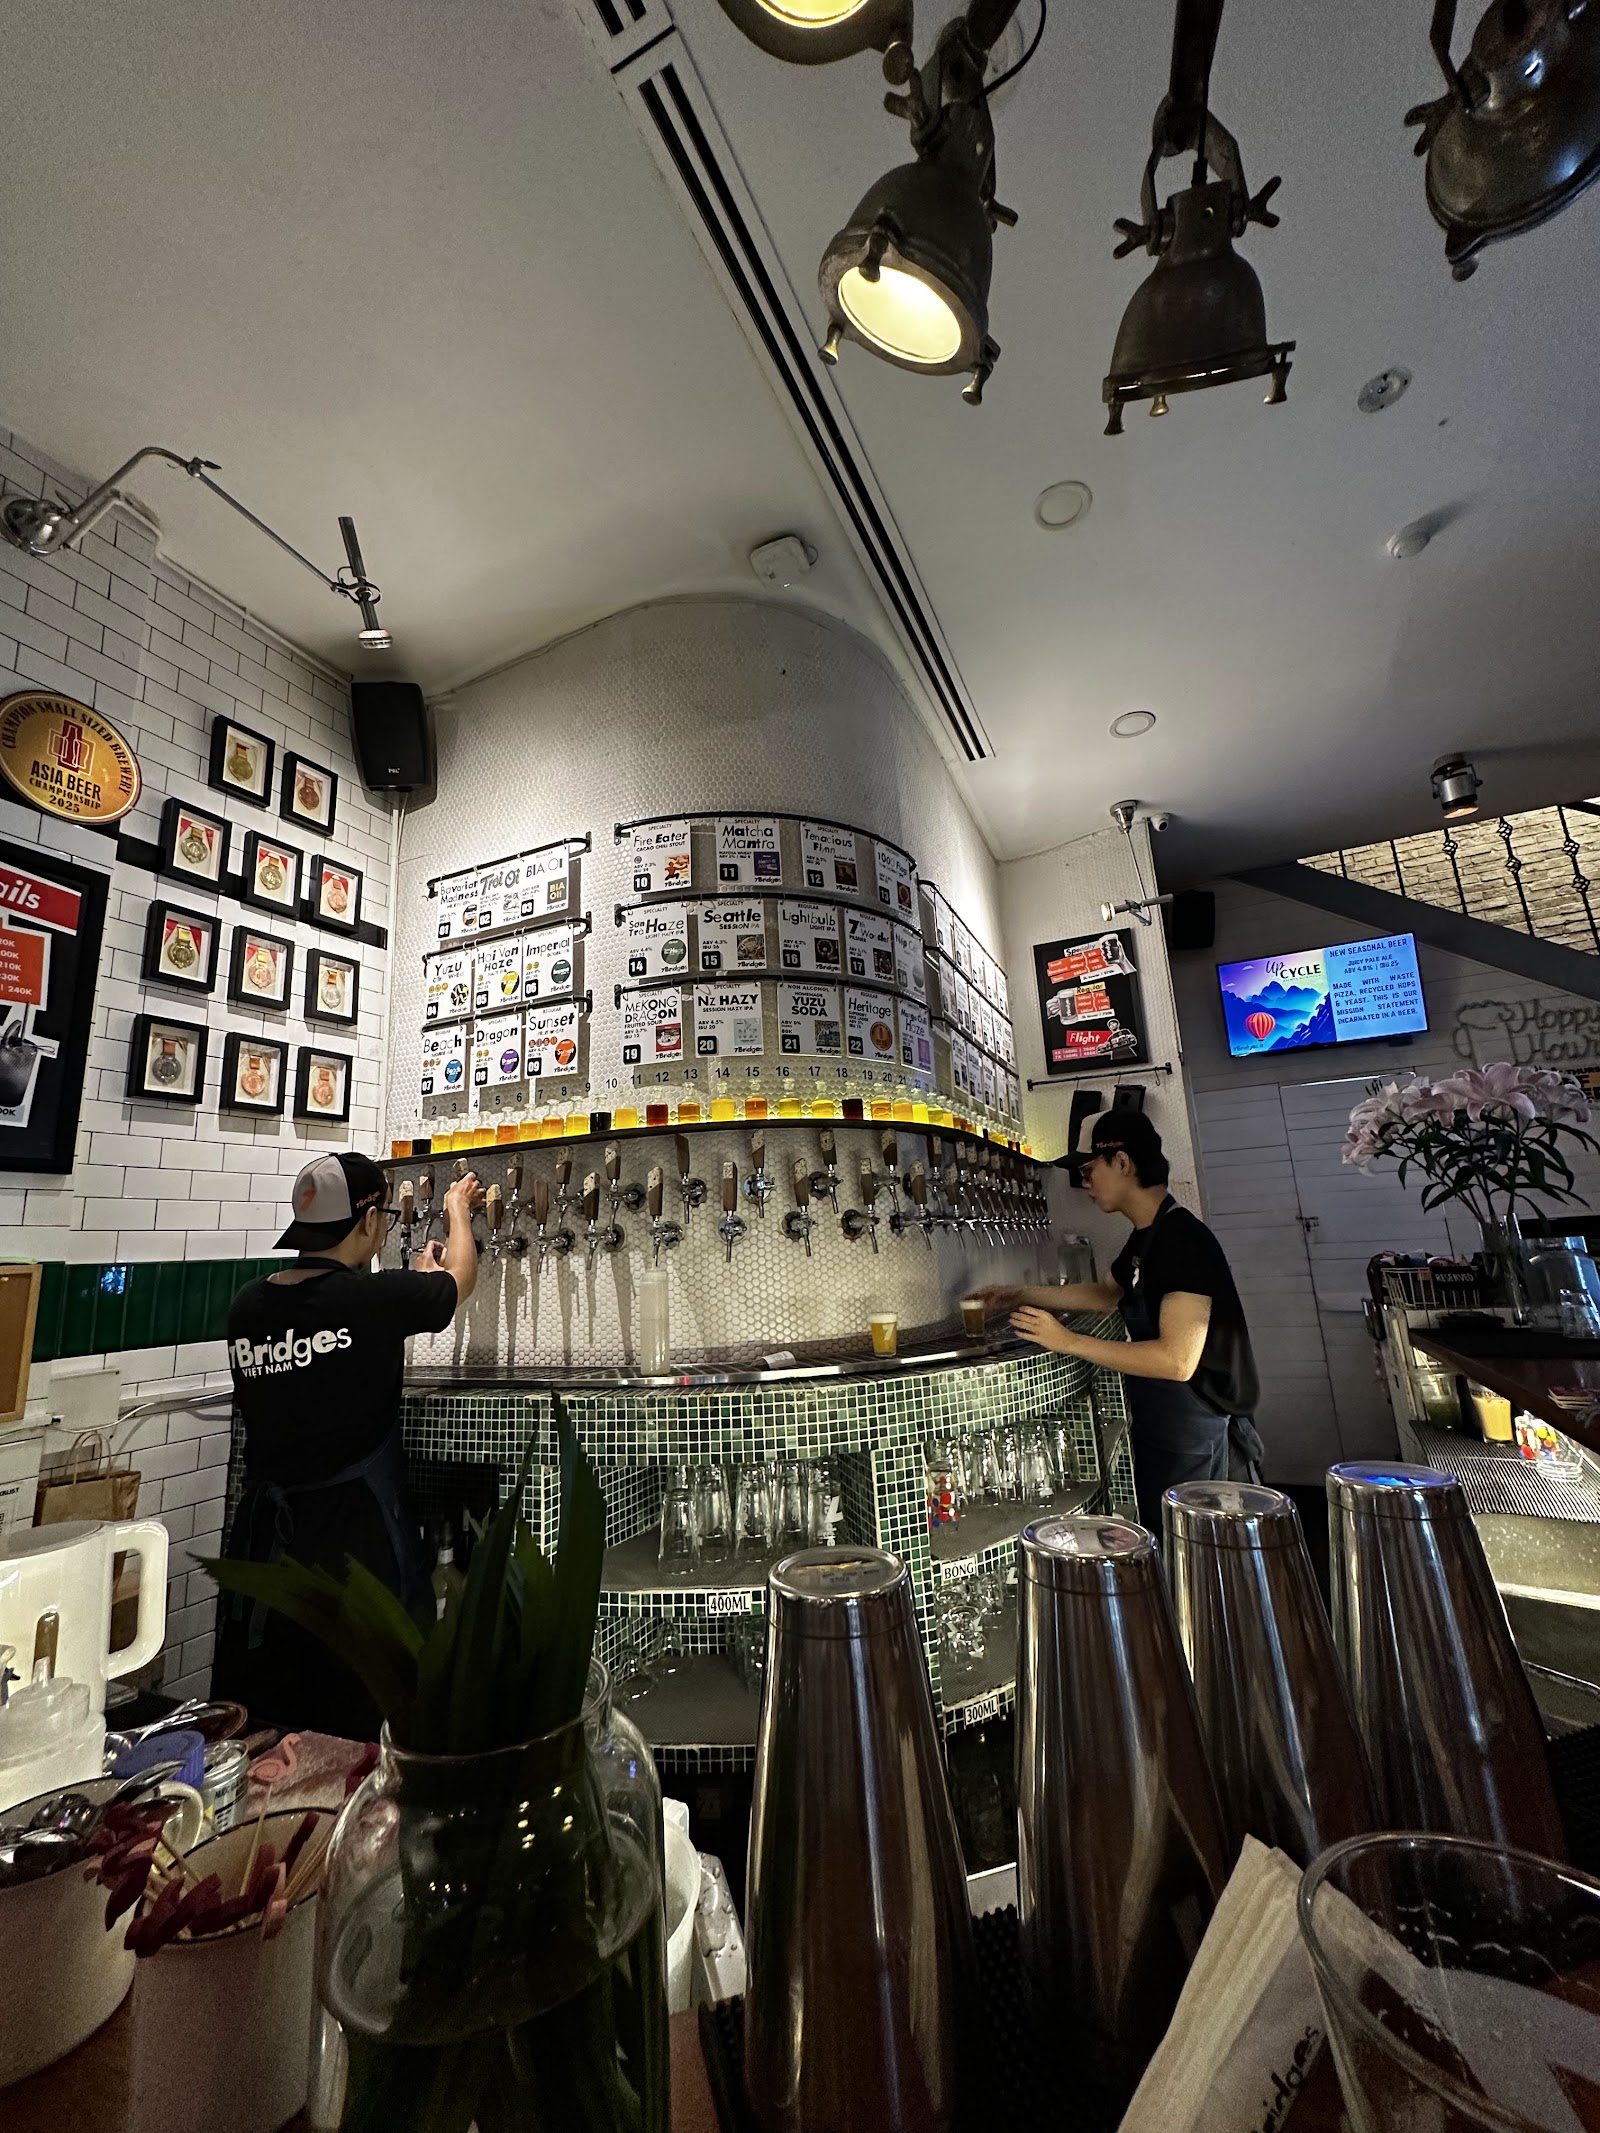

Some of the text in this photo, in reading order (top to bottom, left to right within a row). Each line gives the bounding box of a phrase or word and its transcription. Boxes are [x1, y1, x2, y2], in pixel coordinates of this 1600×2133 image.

[2, 701, 133, 796] CHAMPION SMALL SIZED BREWERY
[31, 760, 101, 801] ASIA BEER
[29, 778, 101, 810] CHAMPIONSHIP
[49, 795, 80, 813] 2025
[648, 823, 672, 831] SPECIALTY
[722, 822, 774, 837] Matcha
[817, 826, 839, 834] SPECIALTY
[634, 832, 688, 848] Fire Eater
[723, 837, 775, 849] Mantra
[804, 829, 853, 848] Tenacious
[526, 862, 545, 878] BIA
[722, 868, 735, 878] 11
[635, 877, 648, 889] 10
[810, 873, 822, 884] 12
[550, 882, 565, 893] BIA
[440, 890, 479, 905] Madness
[522, 902, 532, 914] 03
[480, 913, 490, 925] 02
[703, 908, 761, 923] Seattle
[783, 910, 836, 926] Lightbulb
[440, 926, 449, 935] 01
[645, 918, 684, 934] Haze
[860, 929, 889, 943] Woder
[526, 938, 570, 958] Imperial
[1066, 943, 1096, 957] Specialty
[1329, 938, 1407, 958] NEW SEASONAL BEER
[477, 946, 519, 964] Hai Van
[704, 955, 718, 966] 15
[785, 954, 798, 964] 16
[1347, 959, 1364, 967] JUICY
[1365, 956, 1380, 964] PALE
[484, 959, 513, 972] Haze
[630, 962, 643, 972] 14
[853, 961, 863, 972] 17
[1280, 963, 1321, 979] CYCLE
[1344, 967, 1356, 975] ABV
[0, 973, 20, 982] 30K
[1333, 972, 1415, 990] MADE WITH WASTE
[8, 986, 32, 996] 240K
[526, 983, 537, 994] 06
[639, 990, 663, 998] SPECIALTY
[1076, 984, 1103, 994] Regular
[1360, 984, 1394, 995] RECYCLED
[1397, 981, 1416, 989] HOPS
[477, 995, 487, 1005] 05
[625, 995, 678, 1012] MEKONG
[698, 994, 759, 1007] Nz HAZY
[792, 996, 826, 1007] YUZU
[1344, 996, 1368, 1006] YEAST.
[1392, 992, 1400, 1000] IS
[1404, 990, 1417, 998] OUR
[428, 1006, 437, 1016] 04
[791, 1006, 828, 1017] SODA
[849, 997, 891, 1019] Heritage
[1336, 999, 1419, 1016] MISSION STATEMENT
[528, 1012, 575, 1031] Sunset
[625, 1008, 677, 1024] DRAGON
[1338, 1013, 1381, 1025] INCARNATED
[1398, 1008, 1418, 1016] BEER.
[906, 1020, 925, 1037] Haze
[477, 1027, 518, 1045] Dragon
[1070, 1032, 1100, 1045] Flight
[424, 1035, 462, 1054] Beach
[699, 1041, 714, 1051] 20
[784, 1039, 797, 1049] 21
[851, 1041, 862, 1051] 22
[625, 1049, 638, 1059] 19
[528, 1062, 540, 1073] 09
[476, 1071, 486, 1082] 08
[414, 1066, 906, 1117] 1 2 3 4 5 6 7 8 9 10 11 12 13 14 15 16 17 18 19 20 21
[422, 1081, 432, 1091] 07
[1435, 1273, 1474, 1282] RESERVED
[229, 1327, 352, 1369] 7Bridges
[242, 1362, 293, 1379] VIỆT NAM
[711, 1595, 750, 1611] 400ML
[966, 1704, 997, 1723] 300ML
